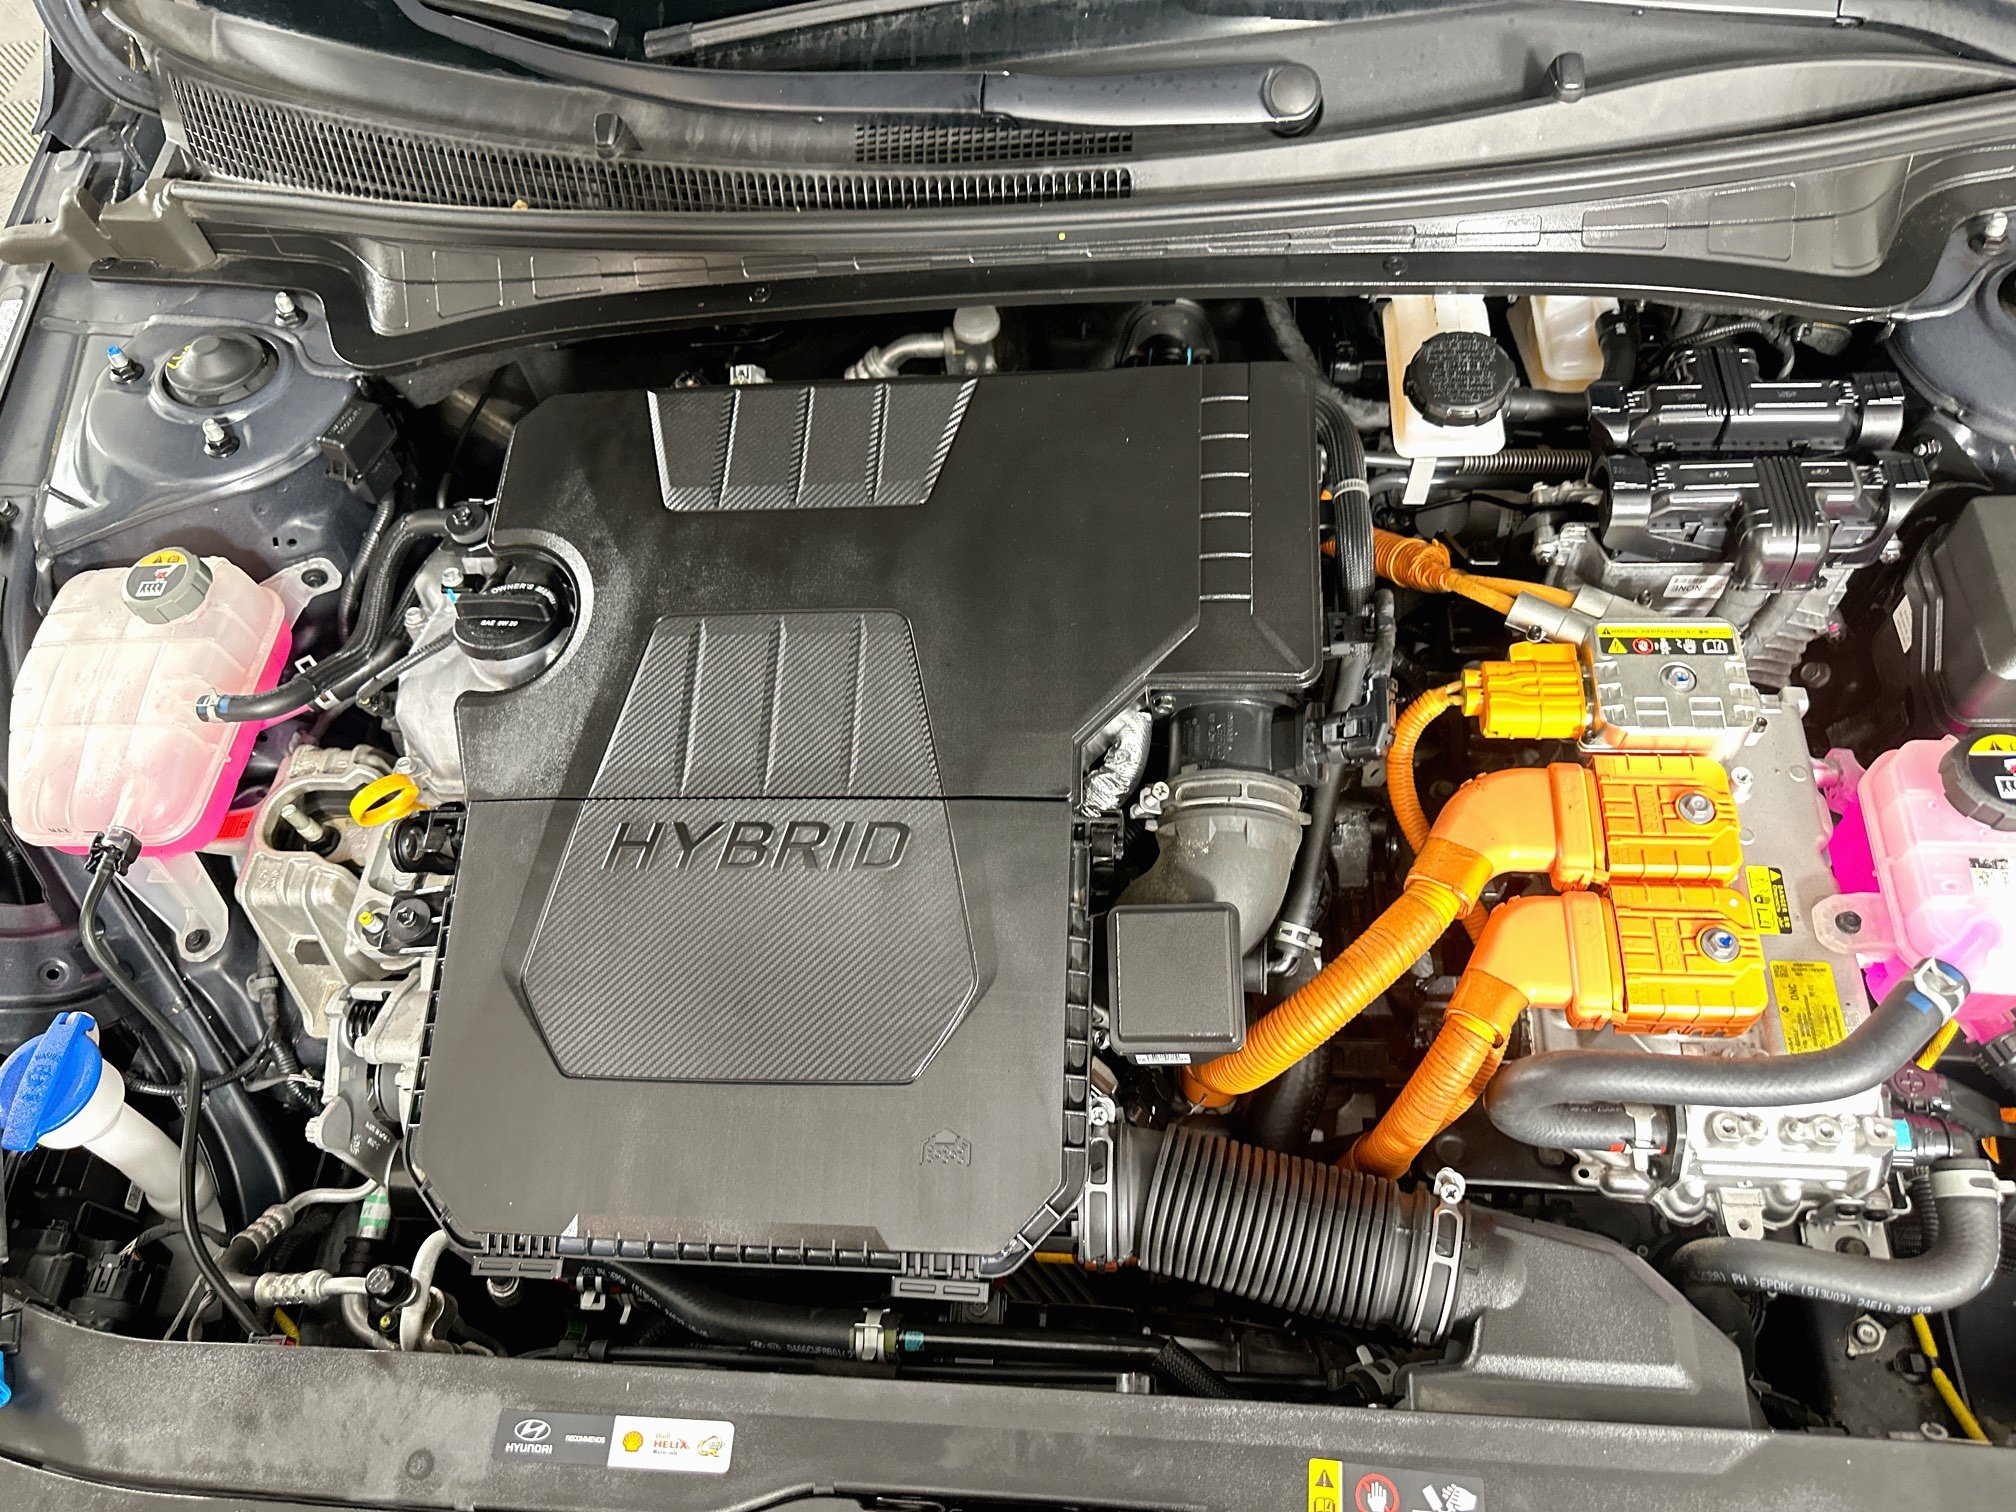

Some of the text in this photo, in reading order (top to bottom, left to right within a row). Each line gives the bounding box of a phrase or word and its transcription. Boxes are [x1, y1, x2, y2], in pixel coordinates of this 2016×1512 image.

[491, 583, 534, 594] OWNER'S
[601, 821, 911, 872] HYBRID
[505, 1442, 552, 1454] HYUNDAI
[654, 1438, 689, 1449] HELIX
